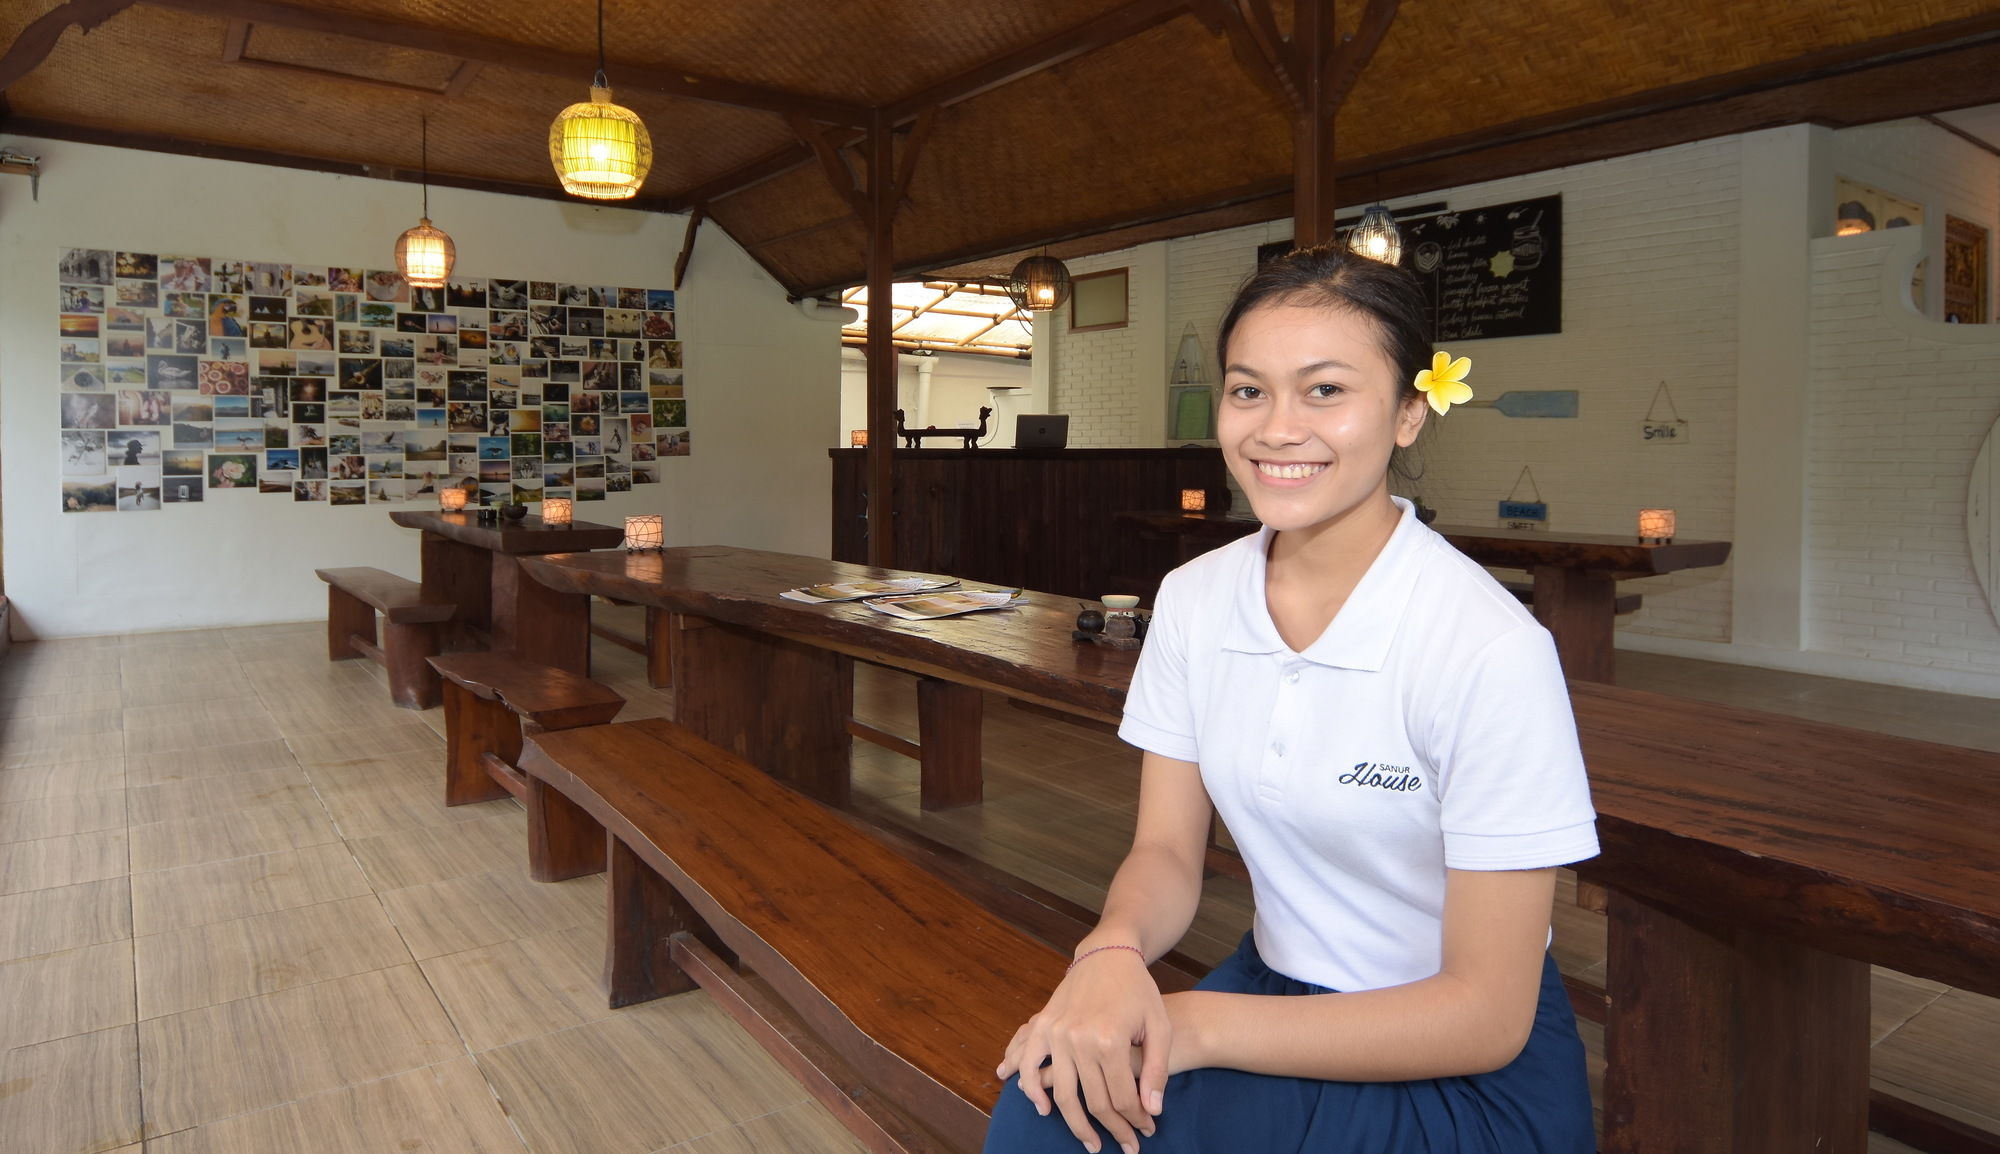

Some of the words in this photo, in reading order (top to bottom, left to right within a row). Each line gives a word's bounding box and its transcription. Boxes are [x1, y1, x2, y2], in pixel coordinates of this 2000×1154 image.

[1643, 424, 1677, 440] Smile
[1506, 505, 1539, 518] BEACH
[1379, 763, 1410, 774] SANUR
[1338, 762, 1422, 792] House
